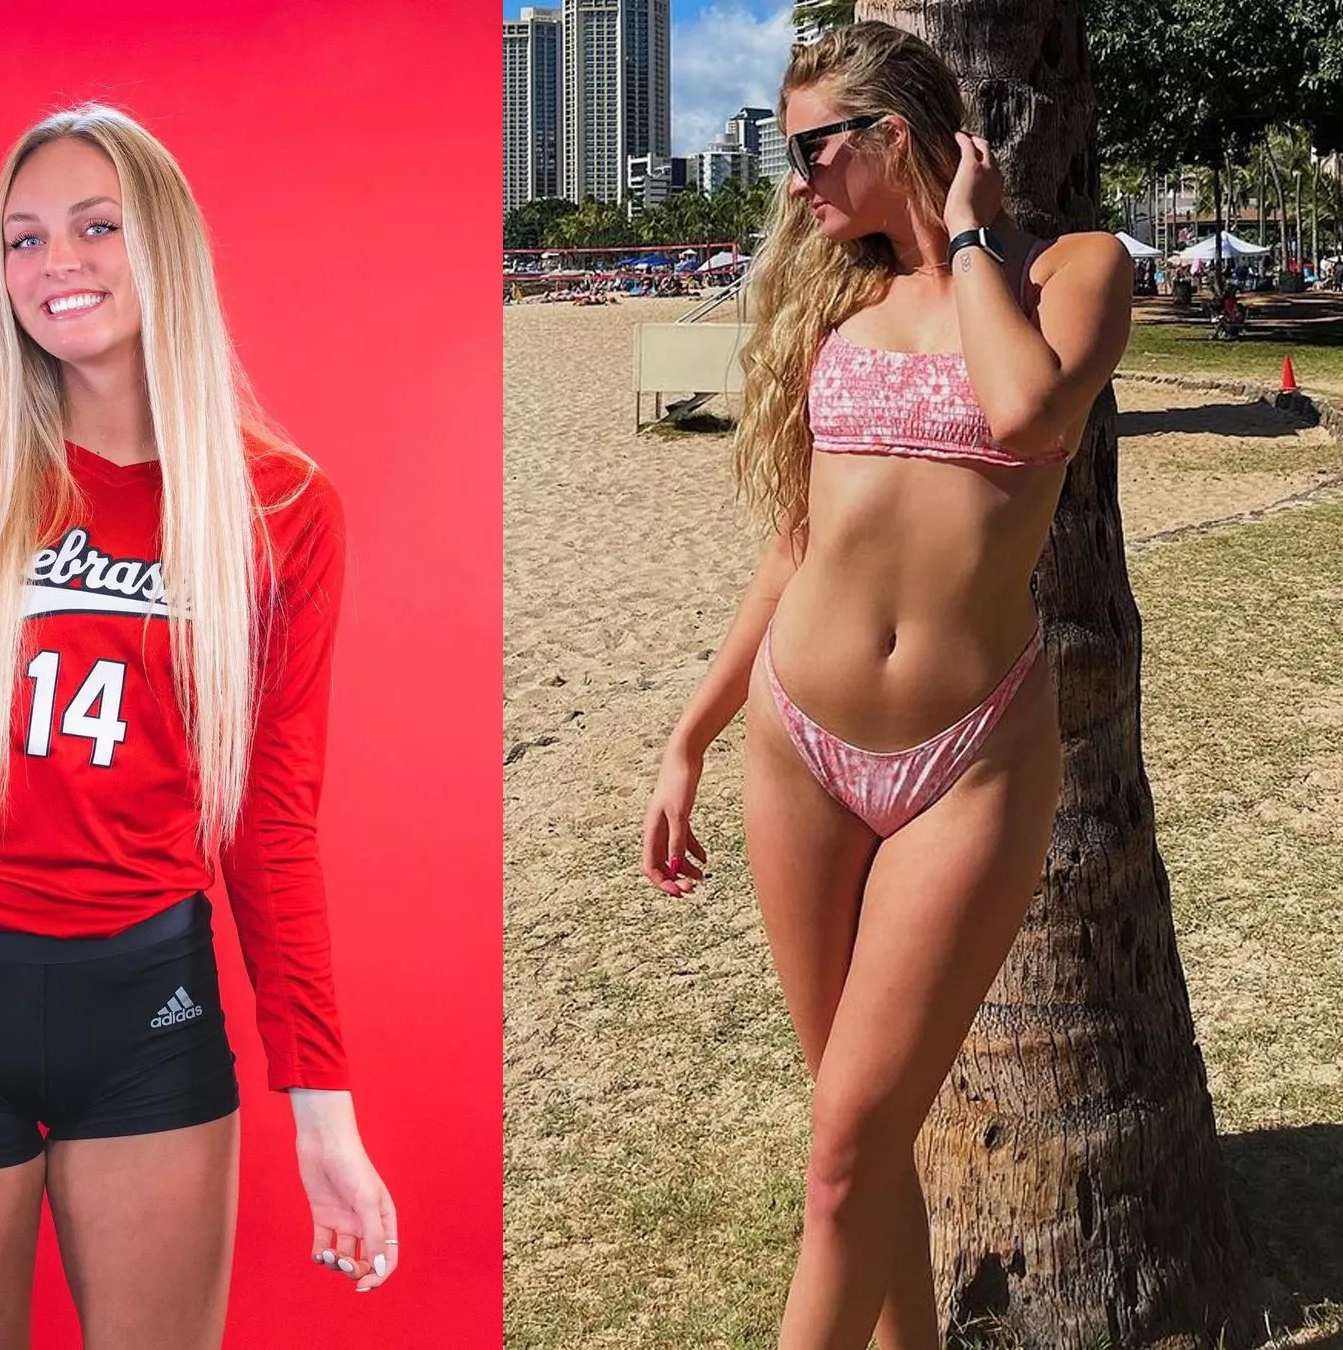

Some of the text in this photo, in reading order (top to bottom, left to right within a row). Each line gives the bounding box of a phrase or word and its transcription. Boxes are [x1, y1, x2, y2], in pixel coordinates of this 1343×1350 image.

[29, 526, 168, 602] ebras
[24, 649, 128, 768] 14
[150, 1005, 203, 1028] adidas
